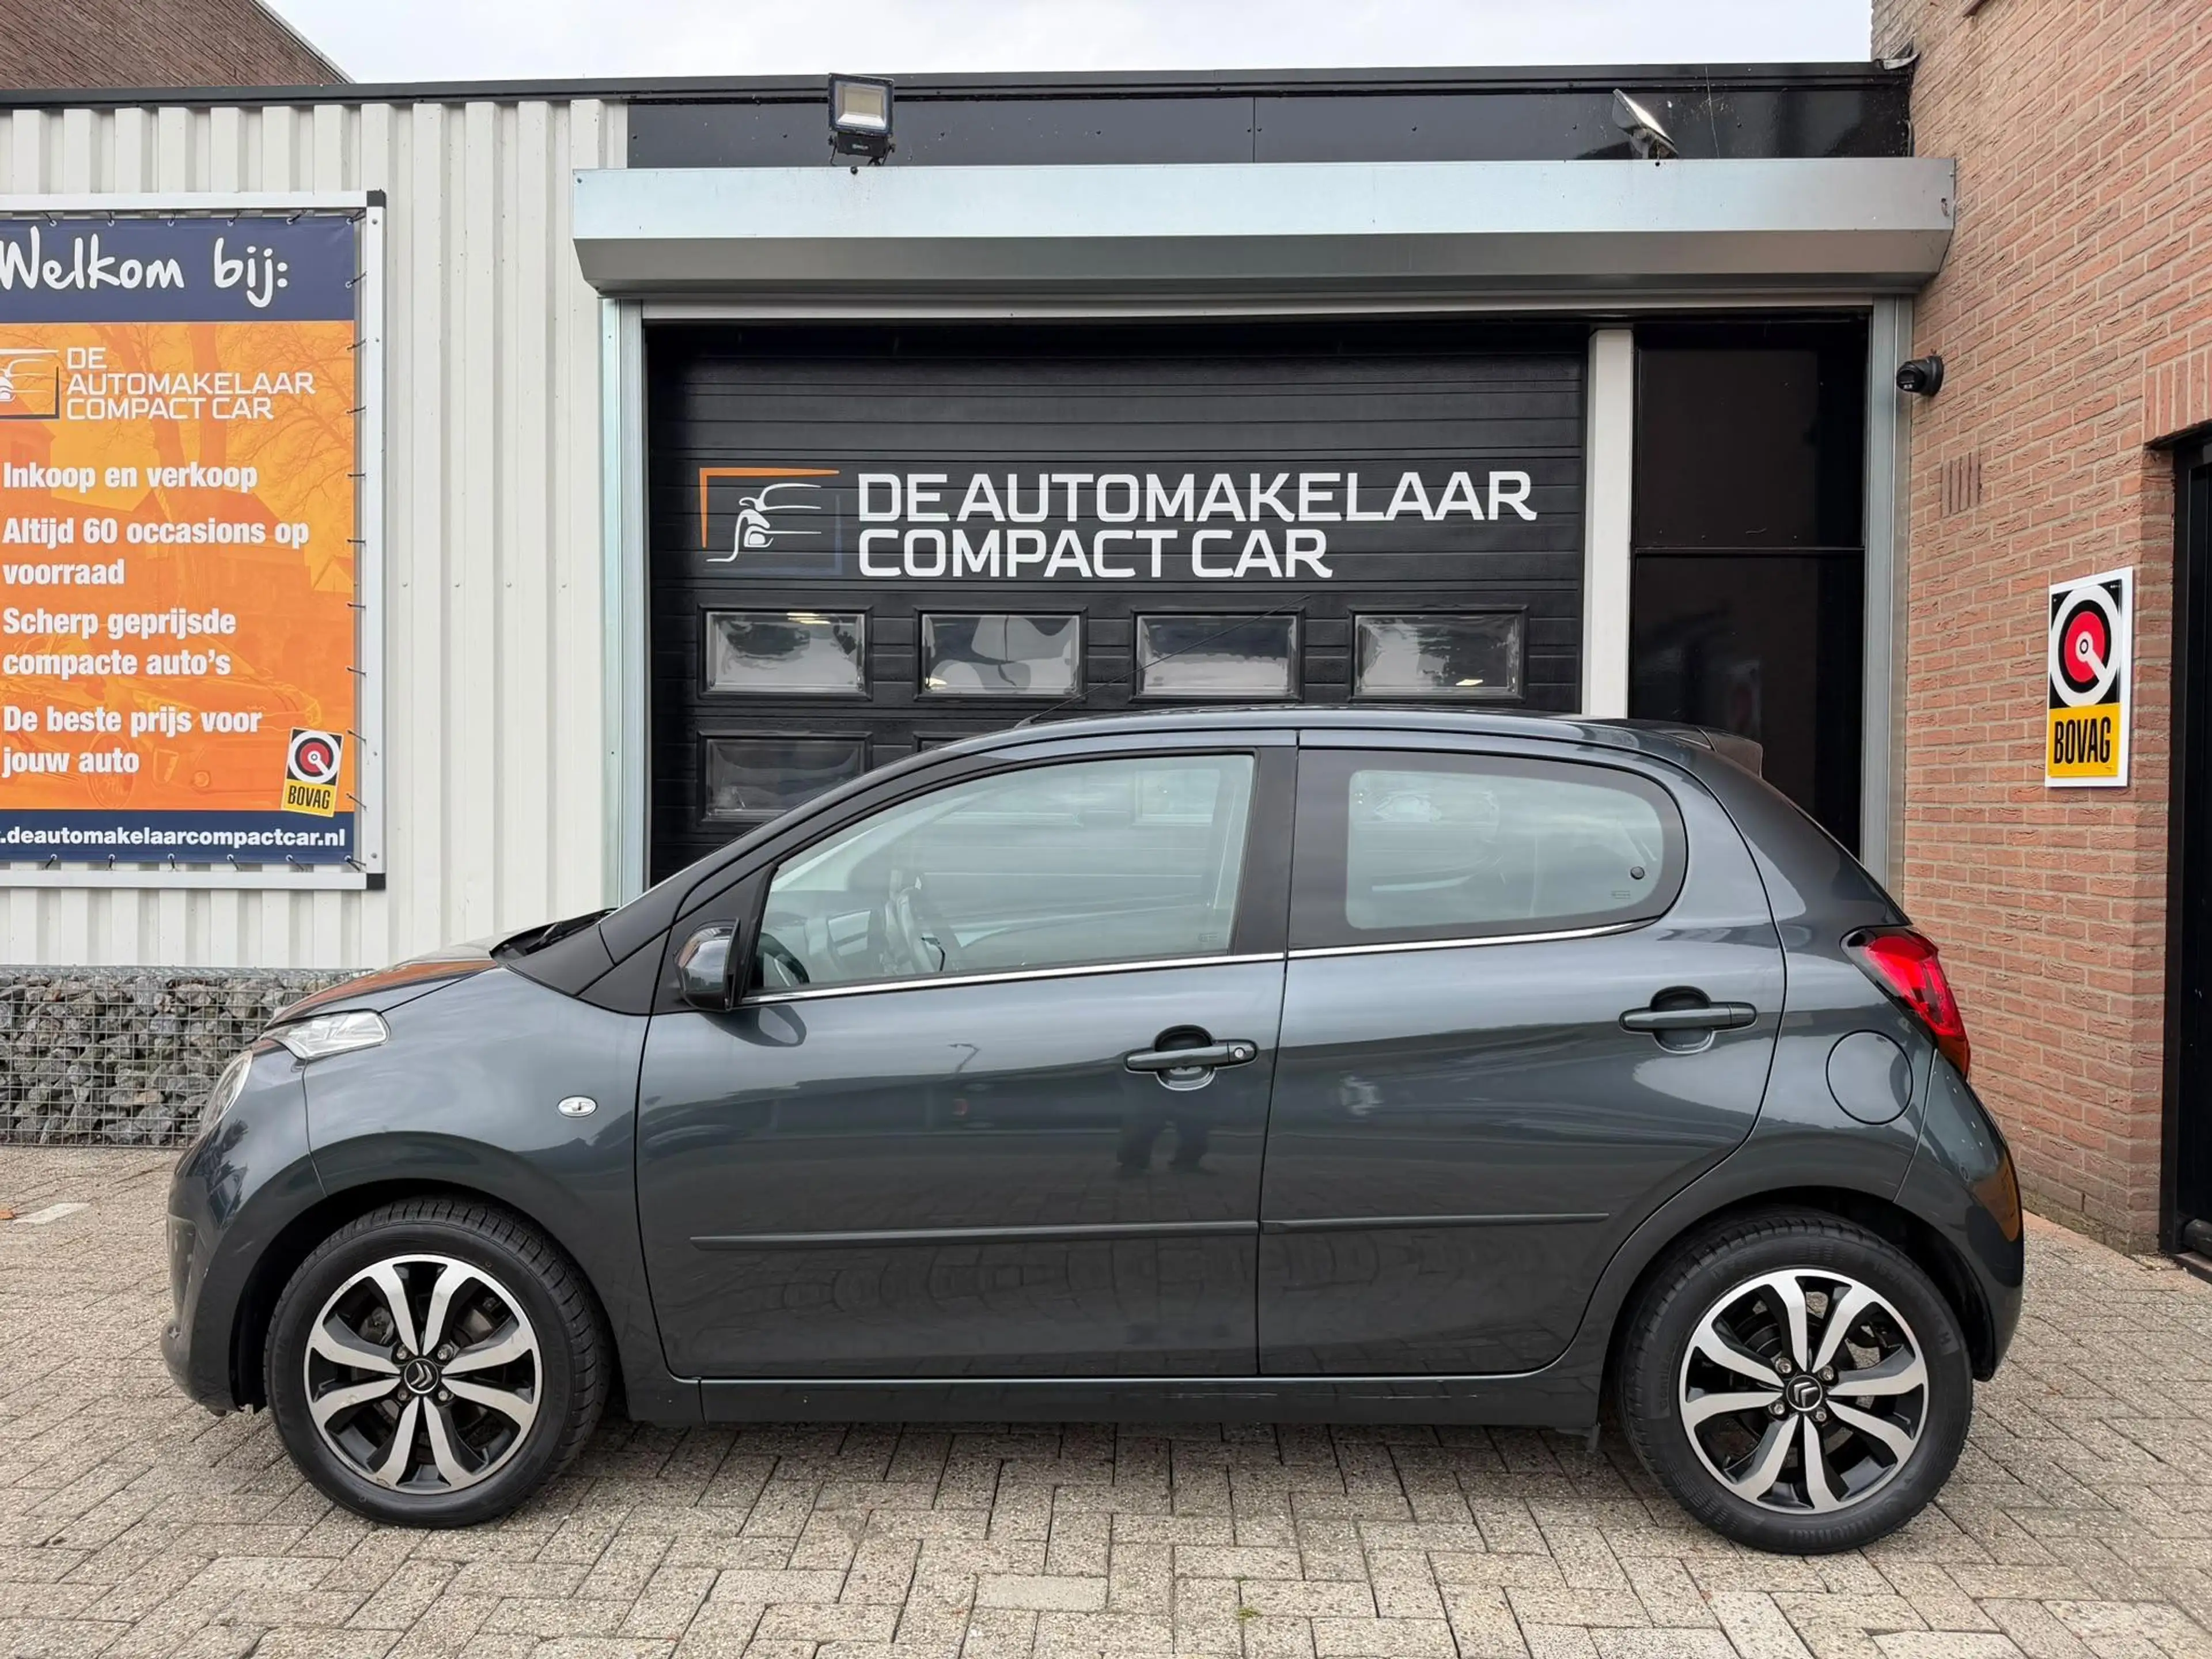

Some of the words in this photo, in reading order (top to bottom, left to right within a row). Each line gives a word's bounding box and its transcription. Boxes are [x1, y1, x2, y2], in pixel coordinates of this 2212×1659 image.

[0, 225, 184, 290] Welkom
[214, 237, 287, 308] bij:
[67, 347, 107, 369] DE
[67, 372, 316, 395] AUTOMAKELAAR
[67, 397, 206, 420] COMPACT
[212, 397, 274, 419] CAR
[4, 462, 96, 493] Inkoop
[105, 467, 137, 488] en
[147, 461, 257, 493] verkoop
[858, 474, 950, 522] DE
[956, 471, 1537, 522] AUTOMAKELAAR
[2, 518, 74, 549] Altijd
[83, 518, 118, 544] 60
[127, 518, 266, 544] occasions
[275, 522, 309, 549] op
[858, 529, 1178, 578] COMPACT
[1191, 529, 1333, 578] CAR
[3, 559, 124, 585] voorraad
[3, 608, 99, 639] Scherp
[108, 608, 236, 639] geprijsde
[3, 650, 138, 680] compacte
[146, 649, 230, 675] auto's
[4, 706, 37, 732] De
[47, 706, 122, 732] beste
[131, 706, 192, 737] prijs
[200, 712, 262, 732] voor
[2054, 717, 2111, 764] BOVAG
[2, 747, 70, 778] jouw
[79, 748, 139, 773] auto
[289, 786, 330, 809] BOVAG
[0, 826, 345, 849] .deautomakelaarcompactcar.nl
